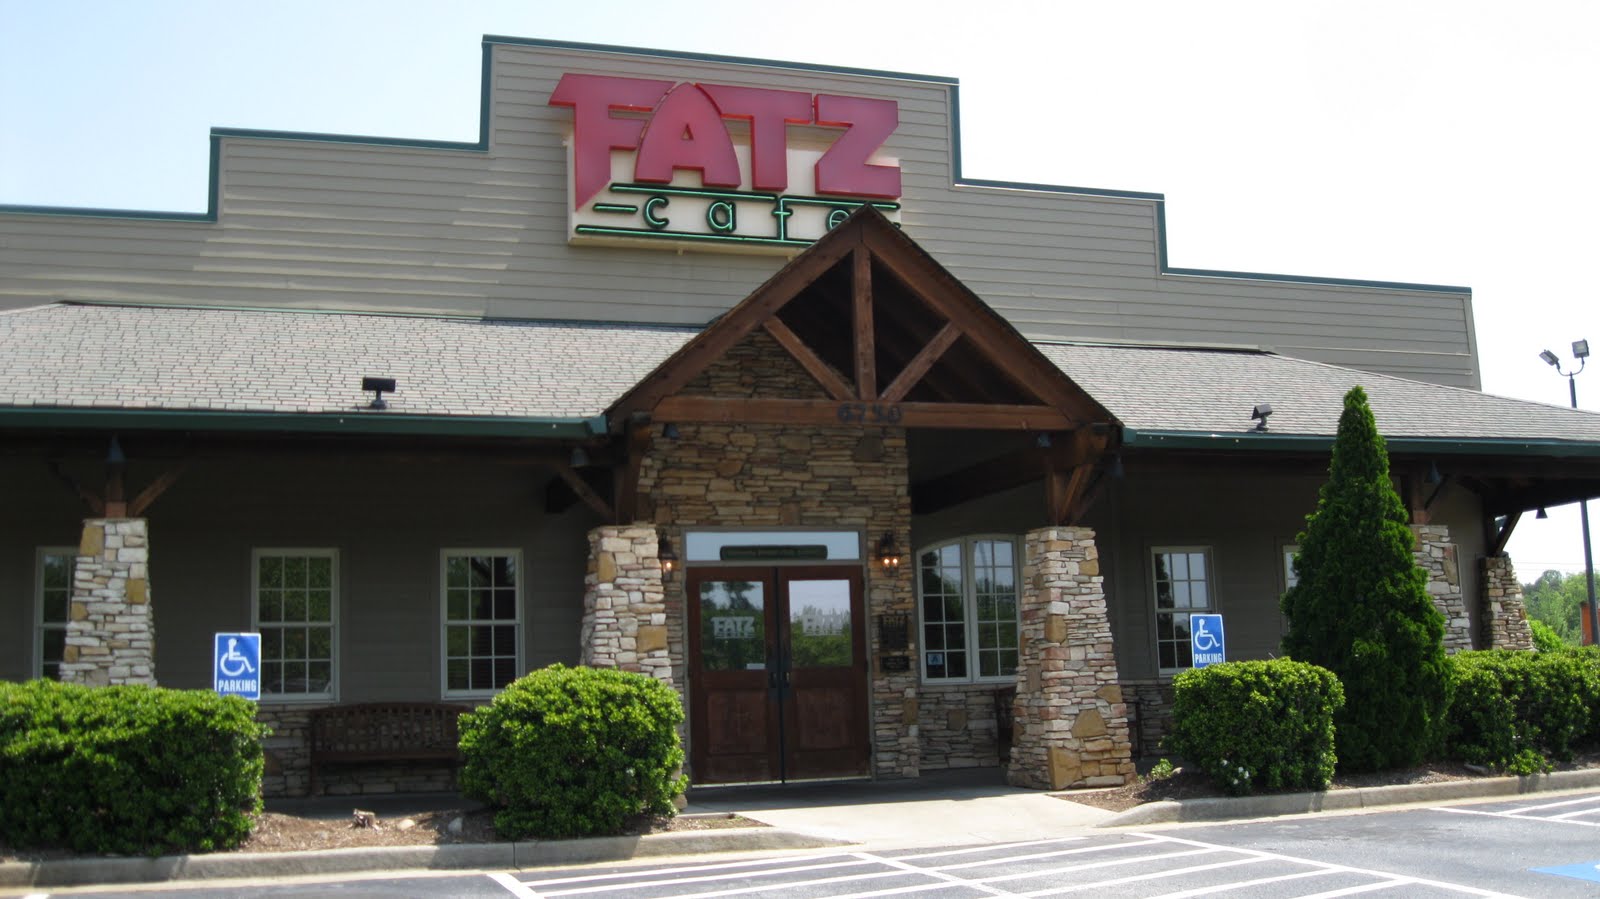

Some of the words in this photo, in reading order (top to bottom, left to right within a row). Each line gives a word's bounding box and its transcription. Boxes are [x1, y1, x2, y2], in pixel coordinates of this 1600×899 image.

[549, 73, 902, 212] FATZ
[1194, 653, 1223, 664] PARKING
[218, 679, 257, 692] PARKING
